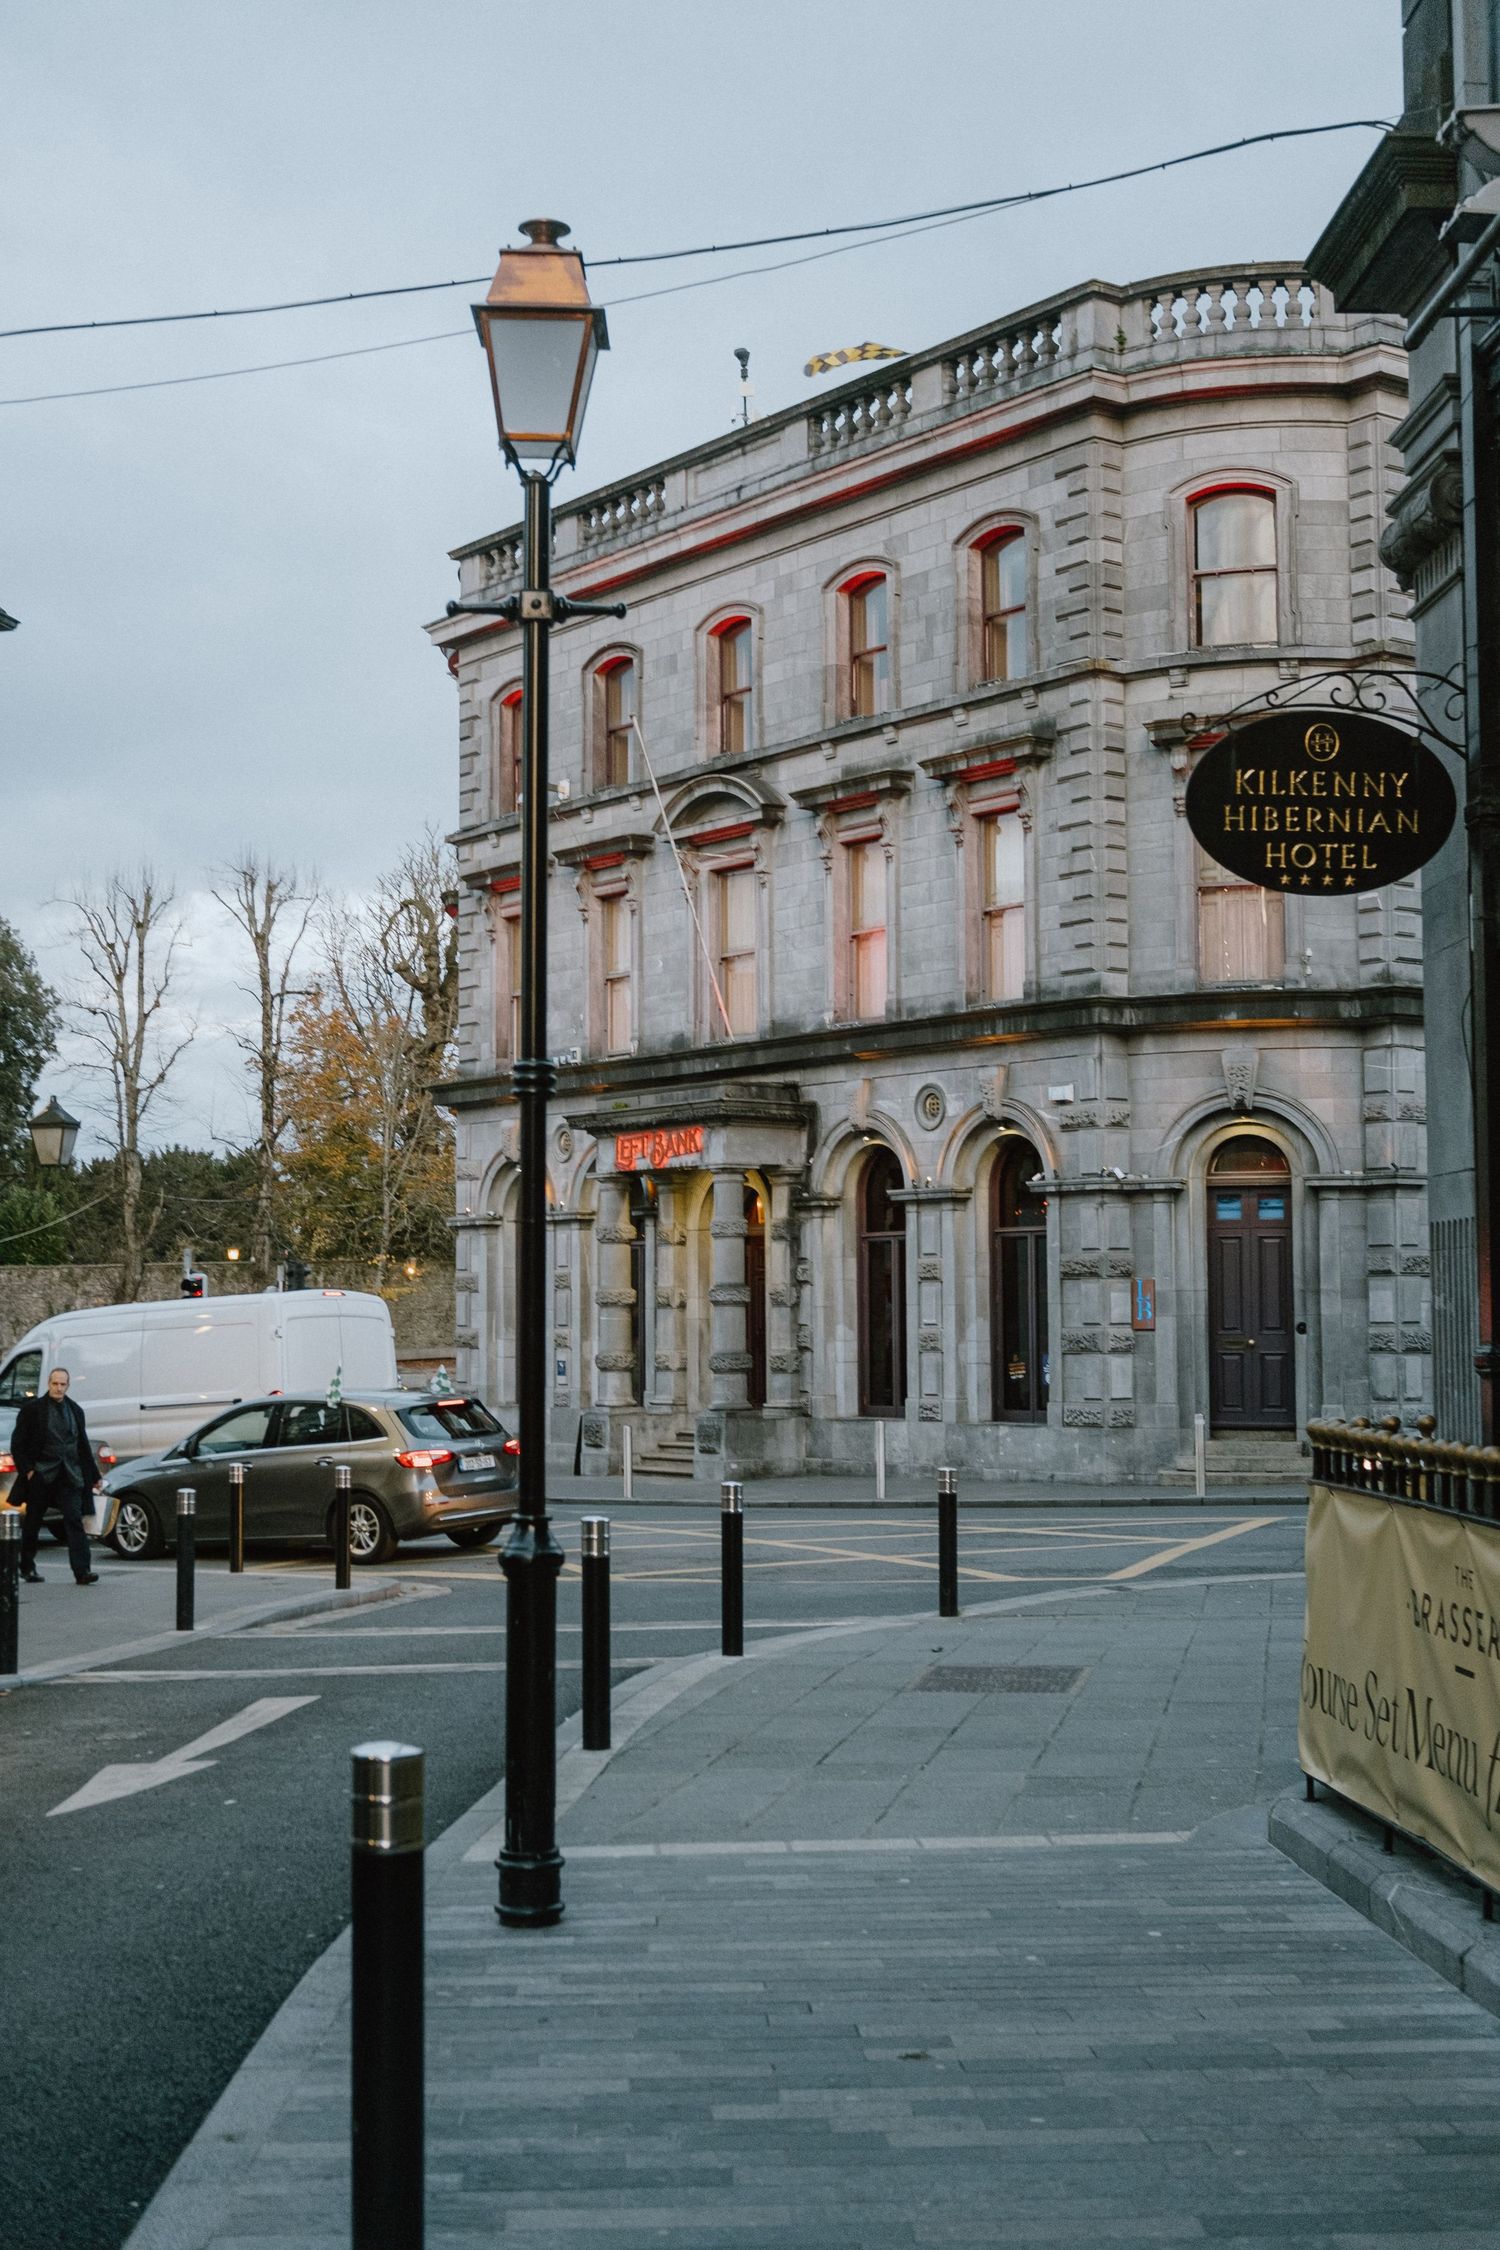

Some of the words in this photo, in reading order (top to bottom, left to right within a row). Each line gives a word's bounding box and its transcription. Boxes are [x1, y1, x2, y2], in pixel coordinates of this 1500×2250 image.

[1235, 768, 1409, 798] KILKENNY
[1223, 804, 1420, 834] HIBERNIAN
[1265, 842, 1378, 869] HOTEL
[615, 1131, 650, 1171] LEFT
[651, 1125, 704, 1168] BANK
[1455, 1565, 1474, 1591] THE
[1365, 1669, 1399, 1754] Set
[1405, 1687, 1480, 1797] Menu
